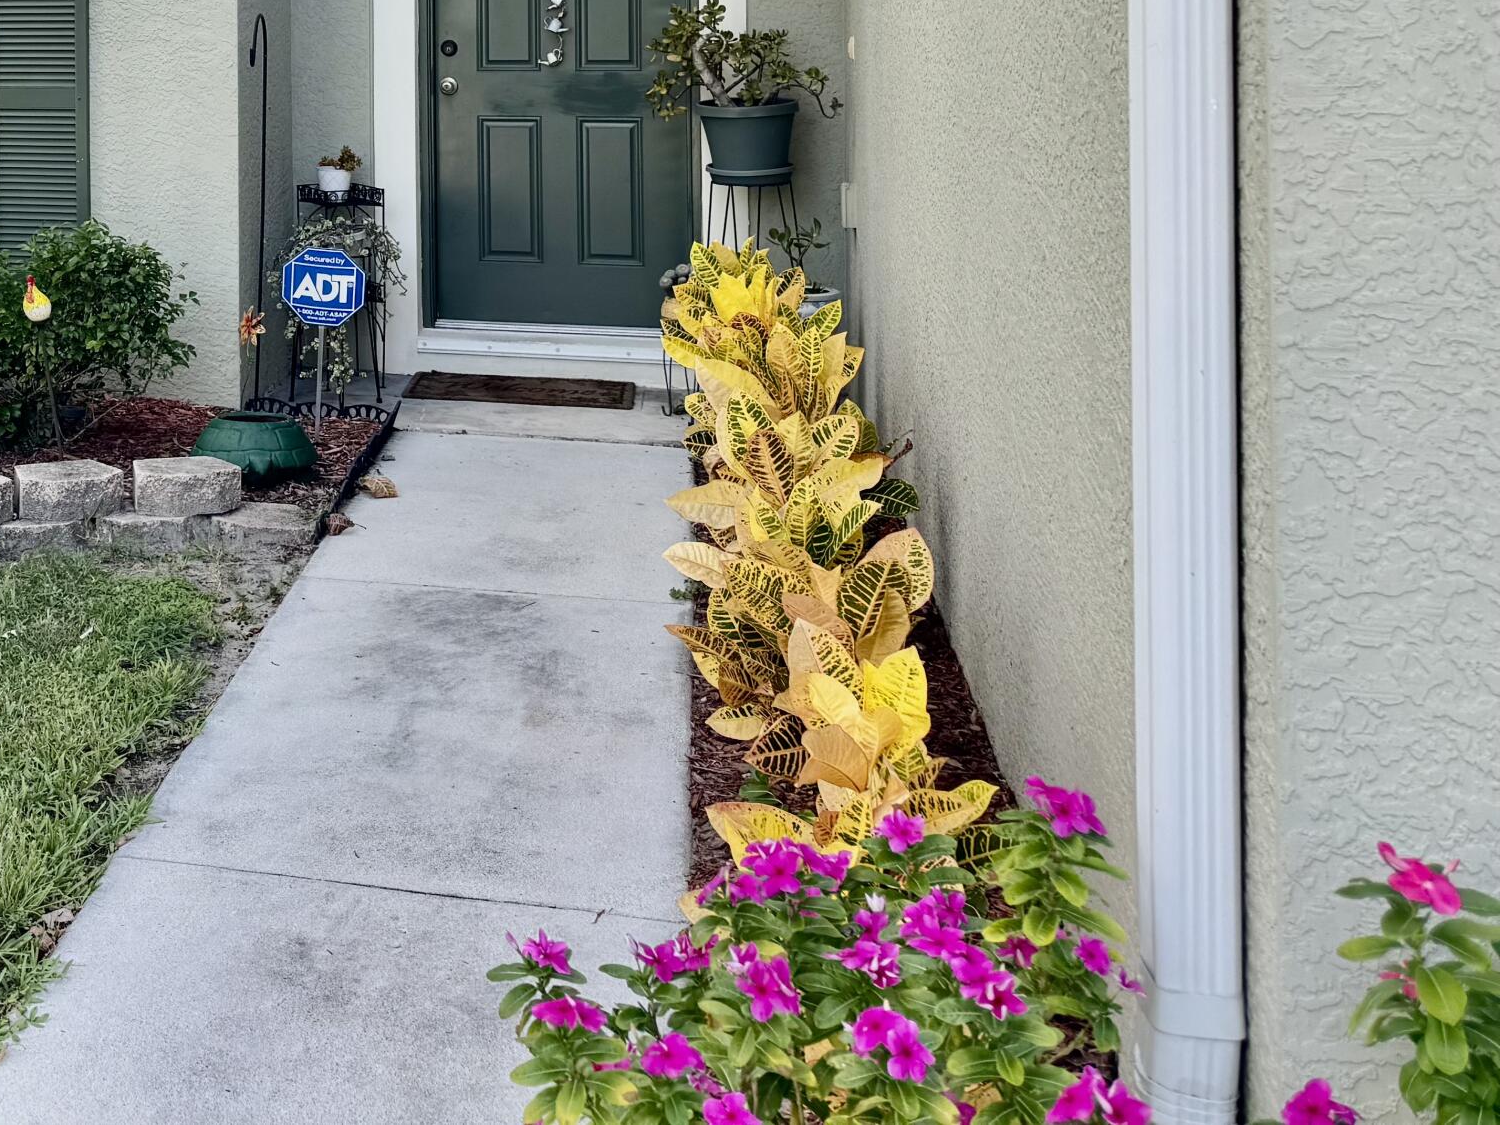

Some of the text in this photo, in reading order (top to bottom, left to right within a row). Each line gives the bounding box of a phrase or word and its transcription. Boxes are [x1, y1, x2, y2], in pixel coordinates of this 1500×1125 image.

[303, 254, 345, 266] Secured by
[293, 271, 355, 304] ADT
